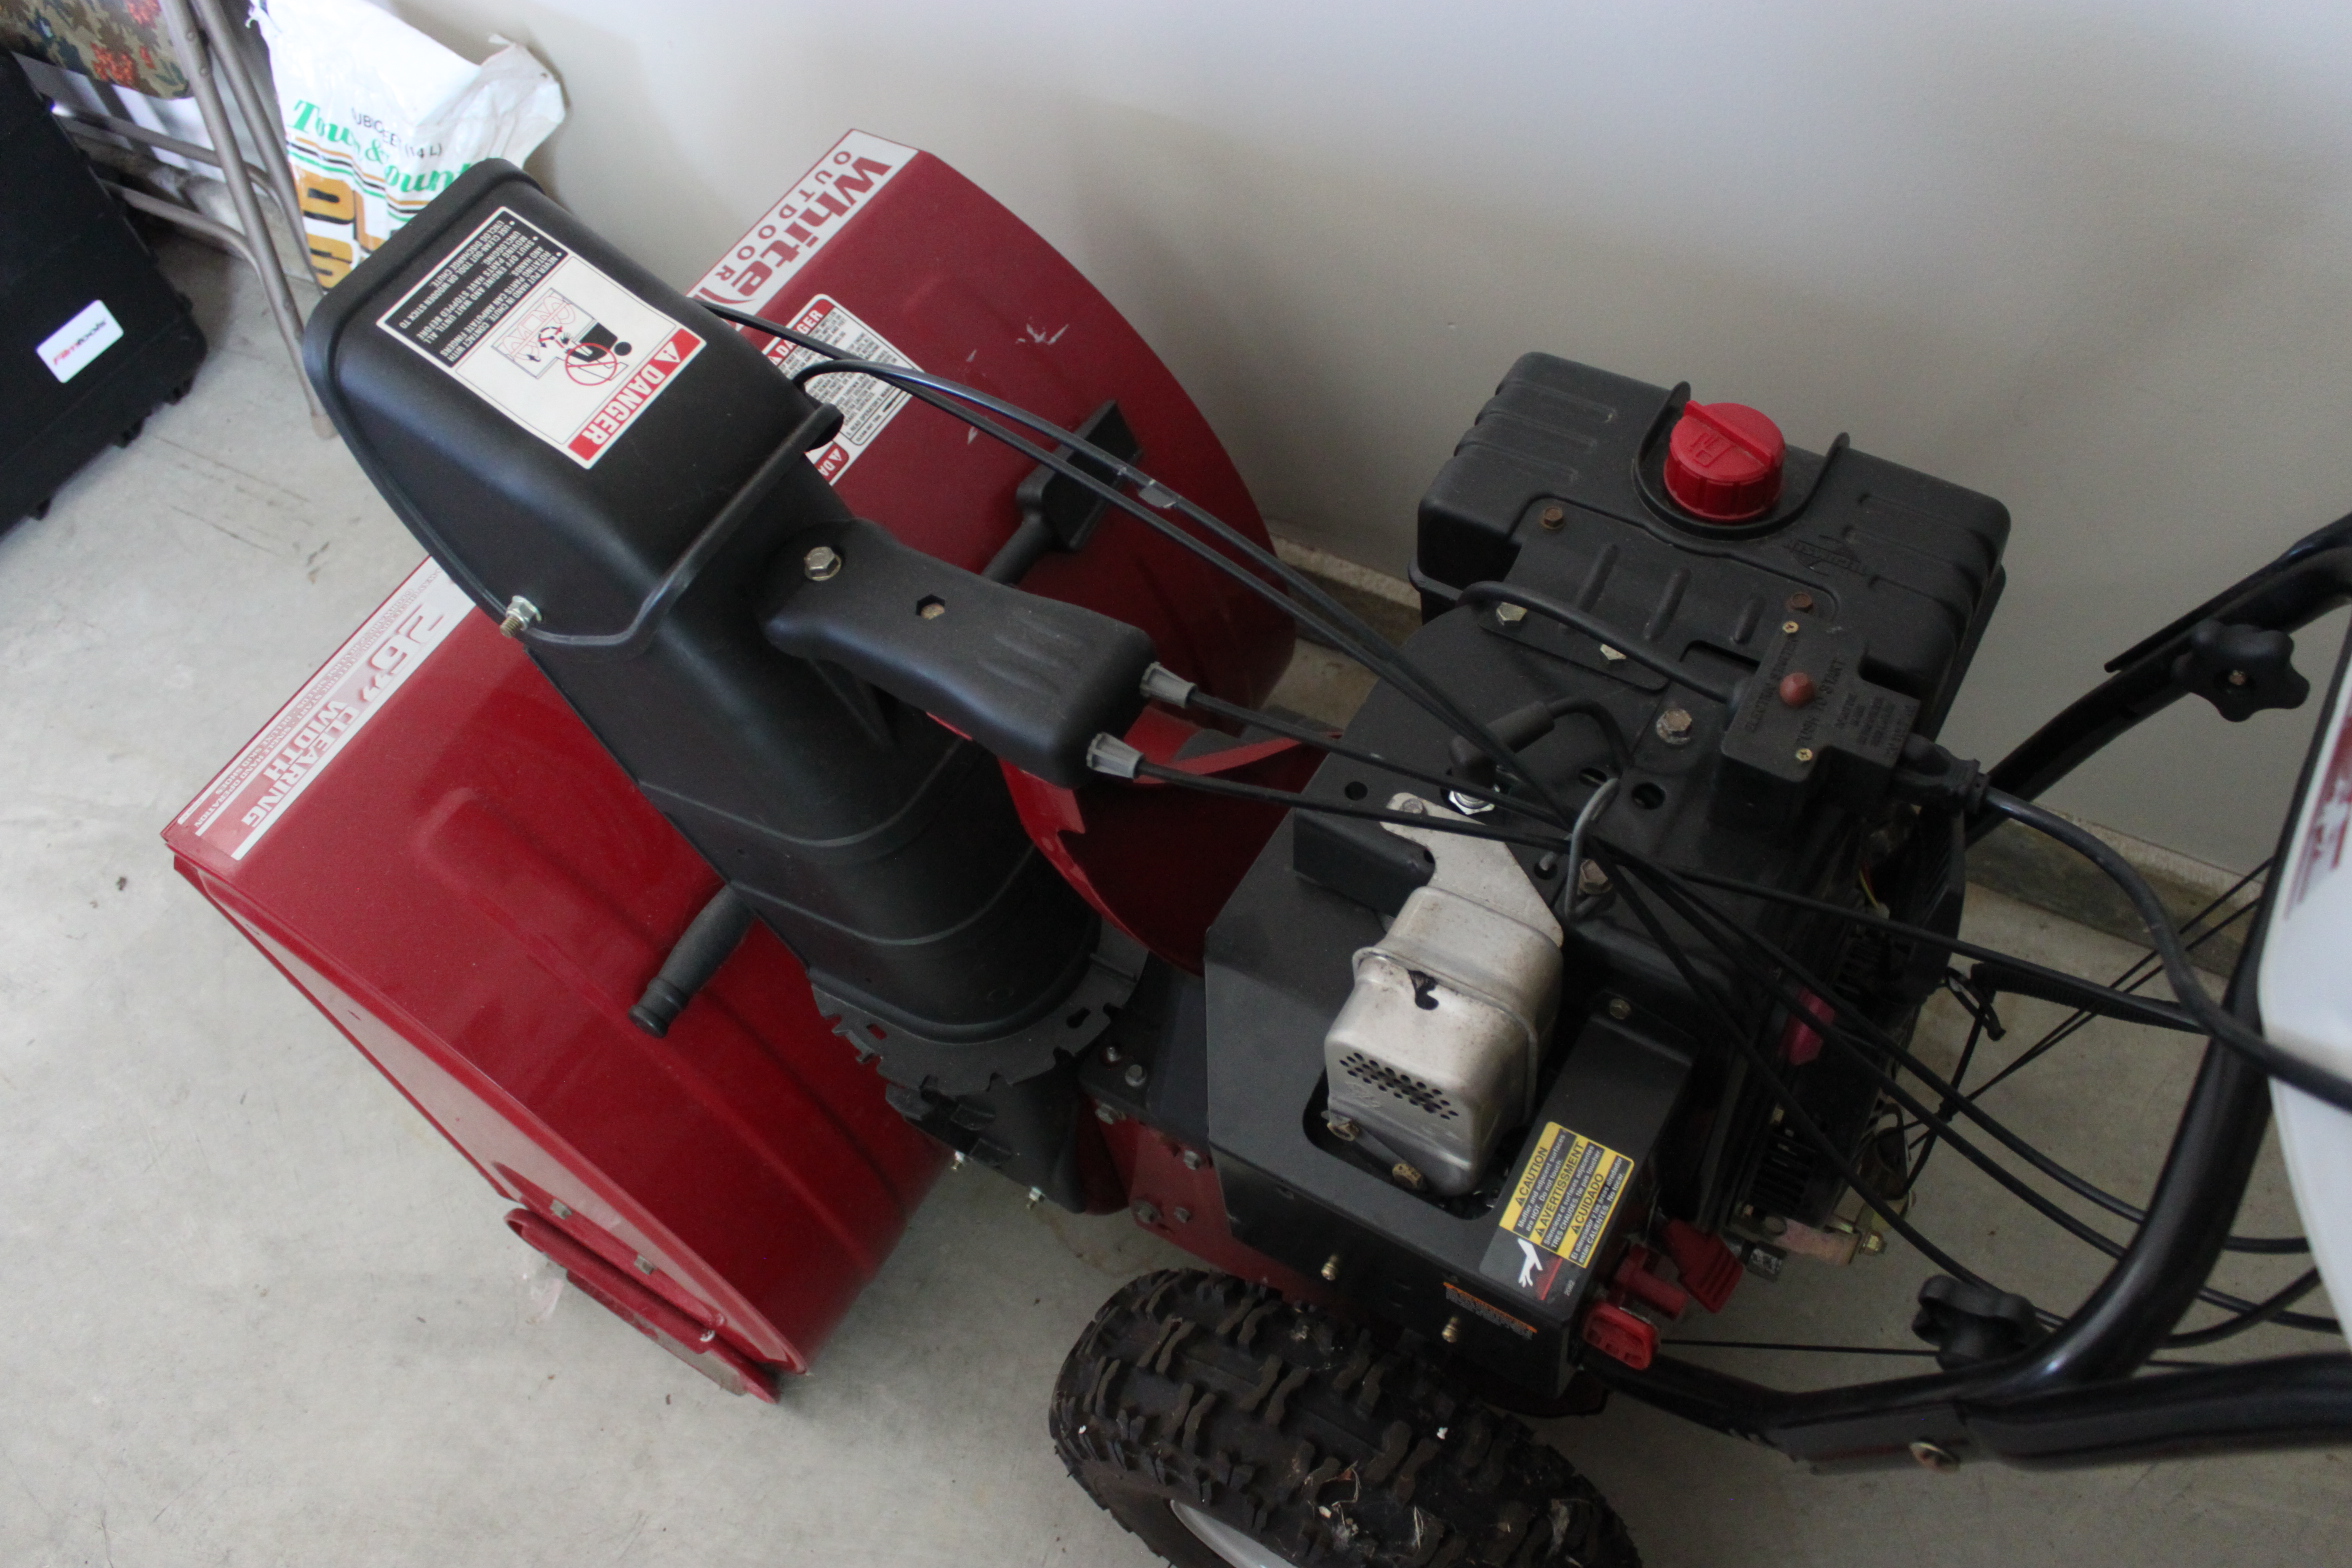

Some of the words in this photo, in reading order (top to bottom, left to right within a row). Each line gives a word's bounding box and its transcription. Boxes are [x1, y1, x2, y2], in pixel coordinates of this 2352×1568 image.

[496, 223, 512, 236] USE
[714, 150, 853, 283] OUTDOOR
[731, 155, 892, 298] White
[478, 219, 505, 242] UNCLOG
[448, 239, 483, 271] DISCHARGE
[468, 233, 501, 263] CLEAN-OUT
[500, 234, 528, 259] MOVING
[515, 238, 535, 256] SHUT
[528, 245, 544, 259] AND
[454, 260, 473, 276] TOOL
[481, 256, 505, 277] PARTS
[503, 253, 519, 268] OFF
[520, 249, 551, 278] ROTATING
[537, 254, 559, 273] NEVER
[445, 273, 459, 284] OR
[465, 274, 486, 292] HAVE
[481, 265, 508, 288] ENGINE
[502, 274, 526, 295] PARTS
[525, 270, 542, 284] PUT
[422, 281, 450, 306] WOODEN
[468, 285, 486, 301] AND
[491, 291, 508, 306] CAN
[504, 295, 516, 305] IN
[510, 281, 531, 299] HAND
[406, 302, 427, 321] STICK
[438, 289, 470, 318] STOPPED
[452, 297, 473, 316] WAIT
[397, 318, 411, 329] TO
[414, 314, 443, 340] BEFORE
[434, 313, 457, 333] UNTIL
[462, 302, 496, 334] AMPUTATE
[421, 330, 439, 345] ALL
[438, 330, 467, 357] FINGERS
[460, 320, 490, 347] CONTACT
[774, 308, 824, 358] DAGER
[445, 344, 465, 362] WITH
[579, 362, 667, 447] DANGER
[295, 677, 329, 710] SPEEDS
[295, 693, 323, 720] START
[259, 714, 293, 747] DELUXE
[259, 695, 348, 781] WIDTH
[261, 725, 293, 755] SINGLE
[237, 704, 362, 828] CLEARING
[238, 754, 265, 780] HAND
[240, 746, 263, 767] SKID
[213, 766, 244, 795] SHOES
[192, 778, 242, 828] OPERATION
[1517, 1145, 1549, 1197] CAUTION
[1574, 1144, 1596, 1179] adjacentes
[1516, 1203, 1533, 1228] Muffler
[1527, 1190, 1539, 1204] and
[1533, 1162, 1554, 1191] adjacent
[1547, 1133, 1566, 1163] surfaces
[1537, 1140, 1586, 1227] AVERTISSMENT
[1561, 1177, 1579, 1206] surfaces
[1524, 1218, 1535, 1231] are
[1537, 1190, 1548, 1202] Do
[1543, 1178, 1553, 1191] not
[1548, 1157, 1563, 1179] touch.
[1573, 1171, 1605, 1225] CUIDADO
[1605, 1190, 1615, 1202] No
[1550, 1229, 1564, 1249] TRES
[1574, 1186, 1584, 1197] Ne
[1579, 1174, 1591, 1188] pas
[1557, 1204, 1567, 1213] et
[1542, 1212, 1563, 1245] Silencieux
